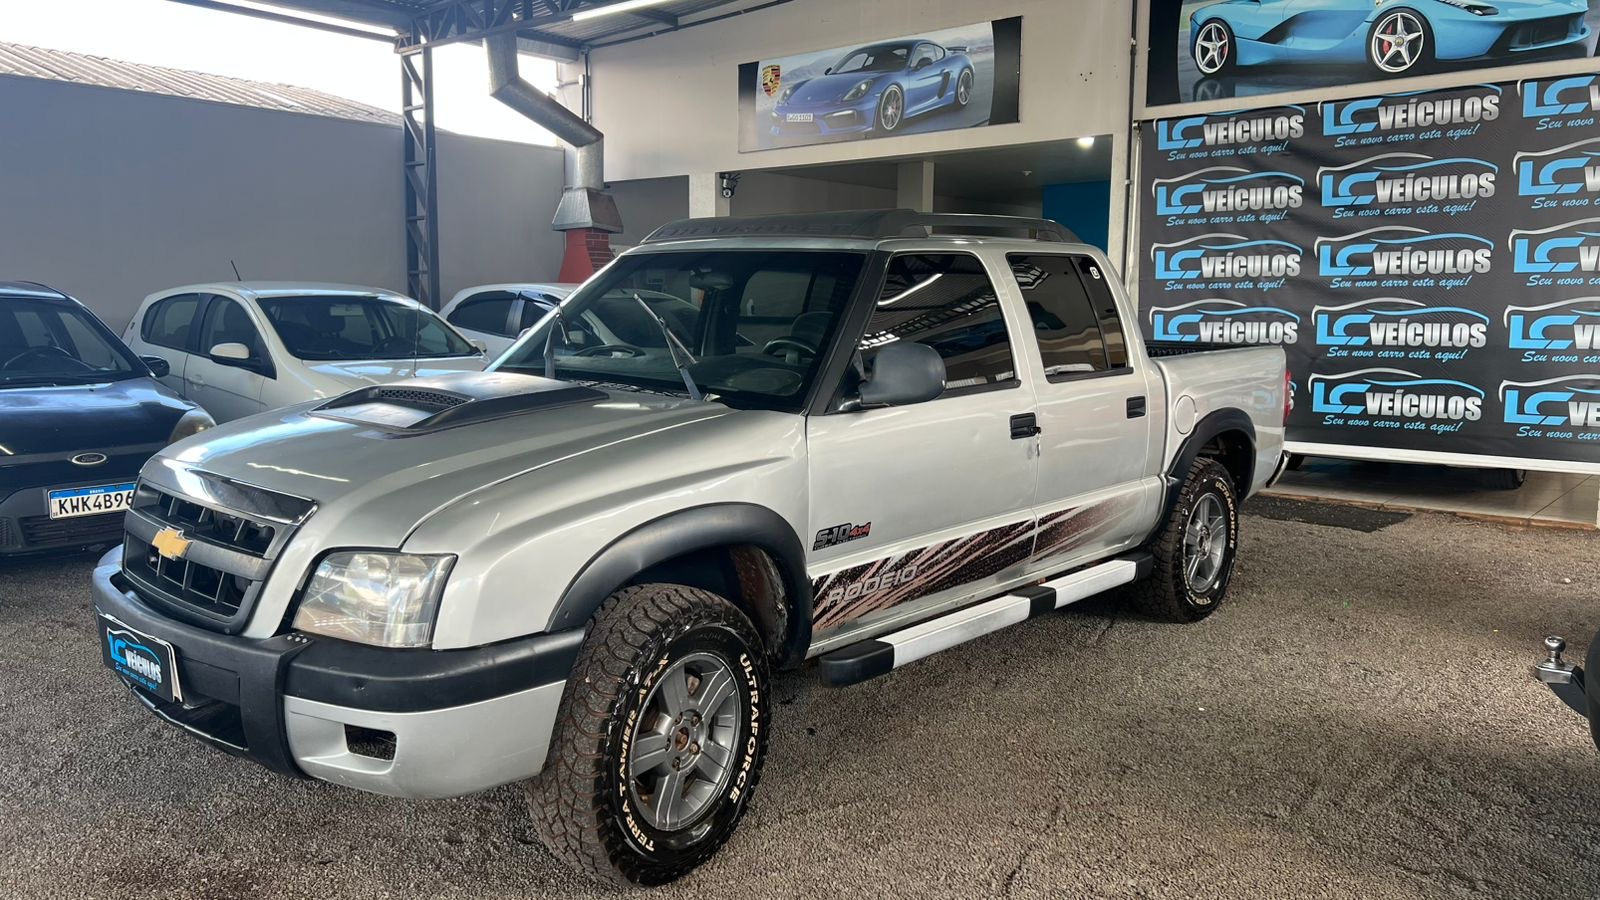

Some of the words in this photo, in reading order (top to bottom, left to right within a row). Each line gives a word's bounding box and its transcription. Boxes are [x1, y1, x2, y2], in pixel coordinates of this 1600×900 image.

[1523, 76, 1596, 118] LC
[1323, 98, 1384, 136] LC
[1378, 95, 1499, 130] VEÍCULOS
[1536, 118, 1562, 130] Seu
[1567, 118, 1594, 127] novo
[1158, 116, 1208, 151] LC
[1203, 115, 1304, 146] VEÍCULOS
[1334, 136, 1357, 148] Seu
[1361, 135, 1383, 144] novo
[1386, 132, 1415, 142] carro
[1419, 129, 1442, 140] esta
[1447, 123, 1480, 141] aqui!
[1321, 171, 1382, 207] LC
[1375, 172, 1496, 203] VEÍCULOS
[1518, 157, 1592, 196] LC
[1156, 183, 1208, 216] LC
[1202, 185, 1303, 212] VEÍCULOS
[1332, 207, 1355, 219] Seu
[1358, 208, 1381, 216] novo
[1384, 207, 1412, 215] carro
[1416, 204, 1440, 214] esta
[1443, 200, 1477, 216] aqui!
[1531, 197, 1557, 209] Seu
[1562, 198, 1588, 207] novo
[1155, 249, 1206, 280] LC
[1201, 252, 1301, 278] VEÍCULOS
[1319, 243, 1378, 276] LC
[1372, 247, 1492, 275] VEÍCULOS
[1513, 236, 1586, 273] LC
[1330, 277, 1352, 289] Seu
[1355, 279, 1377, 287] novo
[1381, 279, 1408, 287] carro
[1413, 277, 1436, 287] esta
[1439, 276, 1472, 289] aqui!
[1526, 275, 1553, 287] Seu
[1557, 276, 1584, 285] novo
[1153, 314, 1204, 341] LC
[1199, 318, 1298, 344] VEÍCULOS
[1315, 314, 1376, 345] LC
[1369, 318, 1487, 348] VEÍCULOS
[1508, 315, 1581, 350] LC
[1327, 347, 1349, 358] Seu
[1352, 349, 1374, 358] novo
[1377, 350, 1404, 358] carro
[1409, 349, 1431, 359] esta
[1435, 349, 1468, 363] aqui!
[1521, 351, 1548, 362] Seu
[1552, 355, 1578, 363] novo
[1583, 355, 1600, 364] car
[1312, 382, 1372, 414] LC
[1366, 389, 1482, 421] VEÍCULOS
[1504, 389, 1576, 426] LC
[1323, 414, 1345, 425] Seu
[1347, 418, 1369, 427] novo
[1373, 420, 1400, 429] carro
[1404, 420, 1426, 430] esta
[1430, 421, 1463, 434] aqui!
[1516, 426, 1542, 437] Seu
[1546, 430, 1573, 439] novo
[827, 565, 918, 607] RODEIO
[729, 653, 760, 803] ULTRAFORCE
[619, 709, 637, 797] TAMER
[622, 799, 655, 851] TERRA
